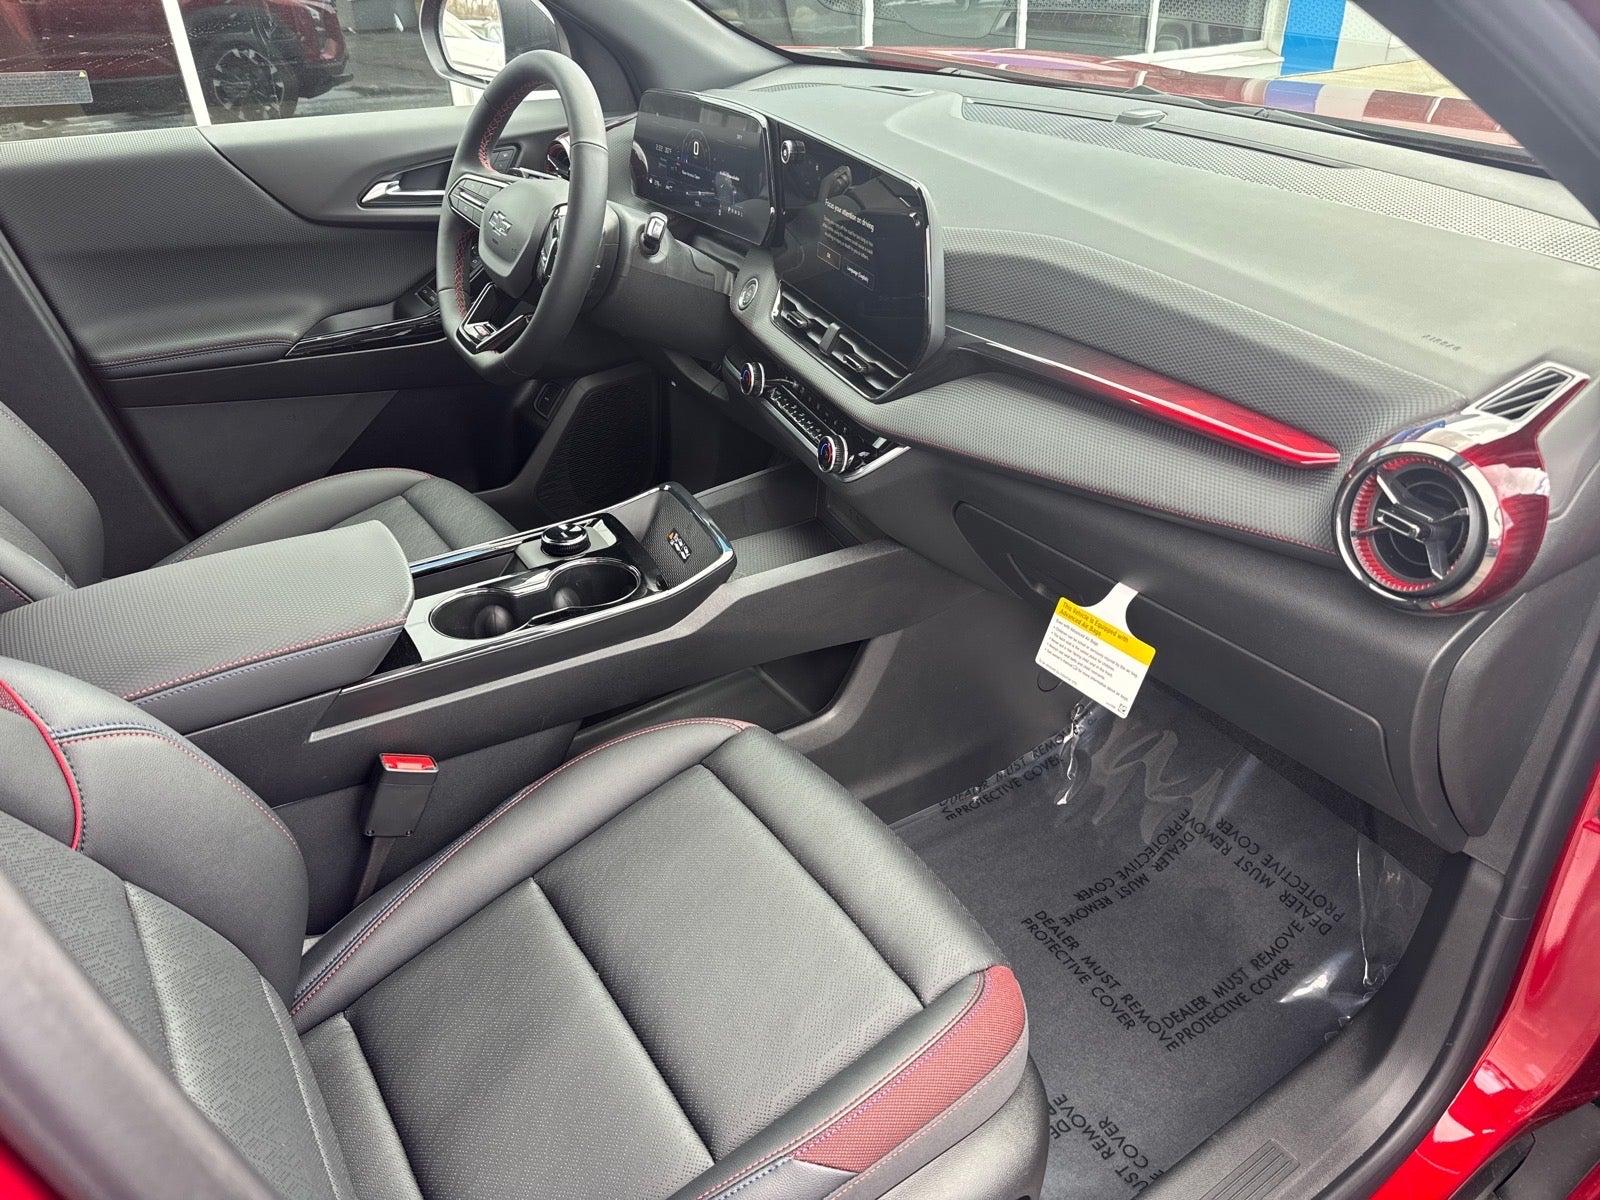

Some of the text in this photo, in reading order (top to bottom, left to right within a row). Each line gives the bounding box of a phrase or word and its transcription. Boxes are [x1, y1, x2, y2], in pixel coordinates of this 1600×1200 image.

[1060, 609, 1081, 625] Advanced
[1063, 601, 1072, 612] This
[1073, 607, 1089, 621] Vehicle
[1094, 619, 1117, 637] Equipped
[1118, 632, 1129, 643] with
[955, 753, 1065, 815] PROTECTIVE COVER
[1059, 831, 1195, 927] DEALER MUST REMOVE
[1074, 819, 1183, 901] PROTECTIVE COVER
[1179, 809, 1332, 936] DEALER MUST REMOVE
[1216, 817, 1345, 923] PROTECTIVE COVER
[1021, 917, 1136, 1030] PROTECTIVE COVER
[1034, 910, 1180, 1052] DEALER MUST REMOVE
[1161, 919, 1305, 1029] DEALER MUST REMOVE
[1175, 958, 1295, 1045] PROTECTIVE COVER
[1053, 1094, 1116, 1160] REMOVE
[1098, 1116, 1149, 1169] COVER
[1114, 1165, 1149, 1192] UST
